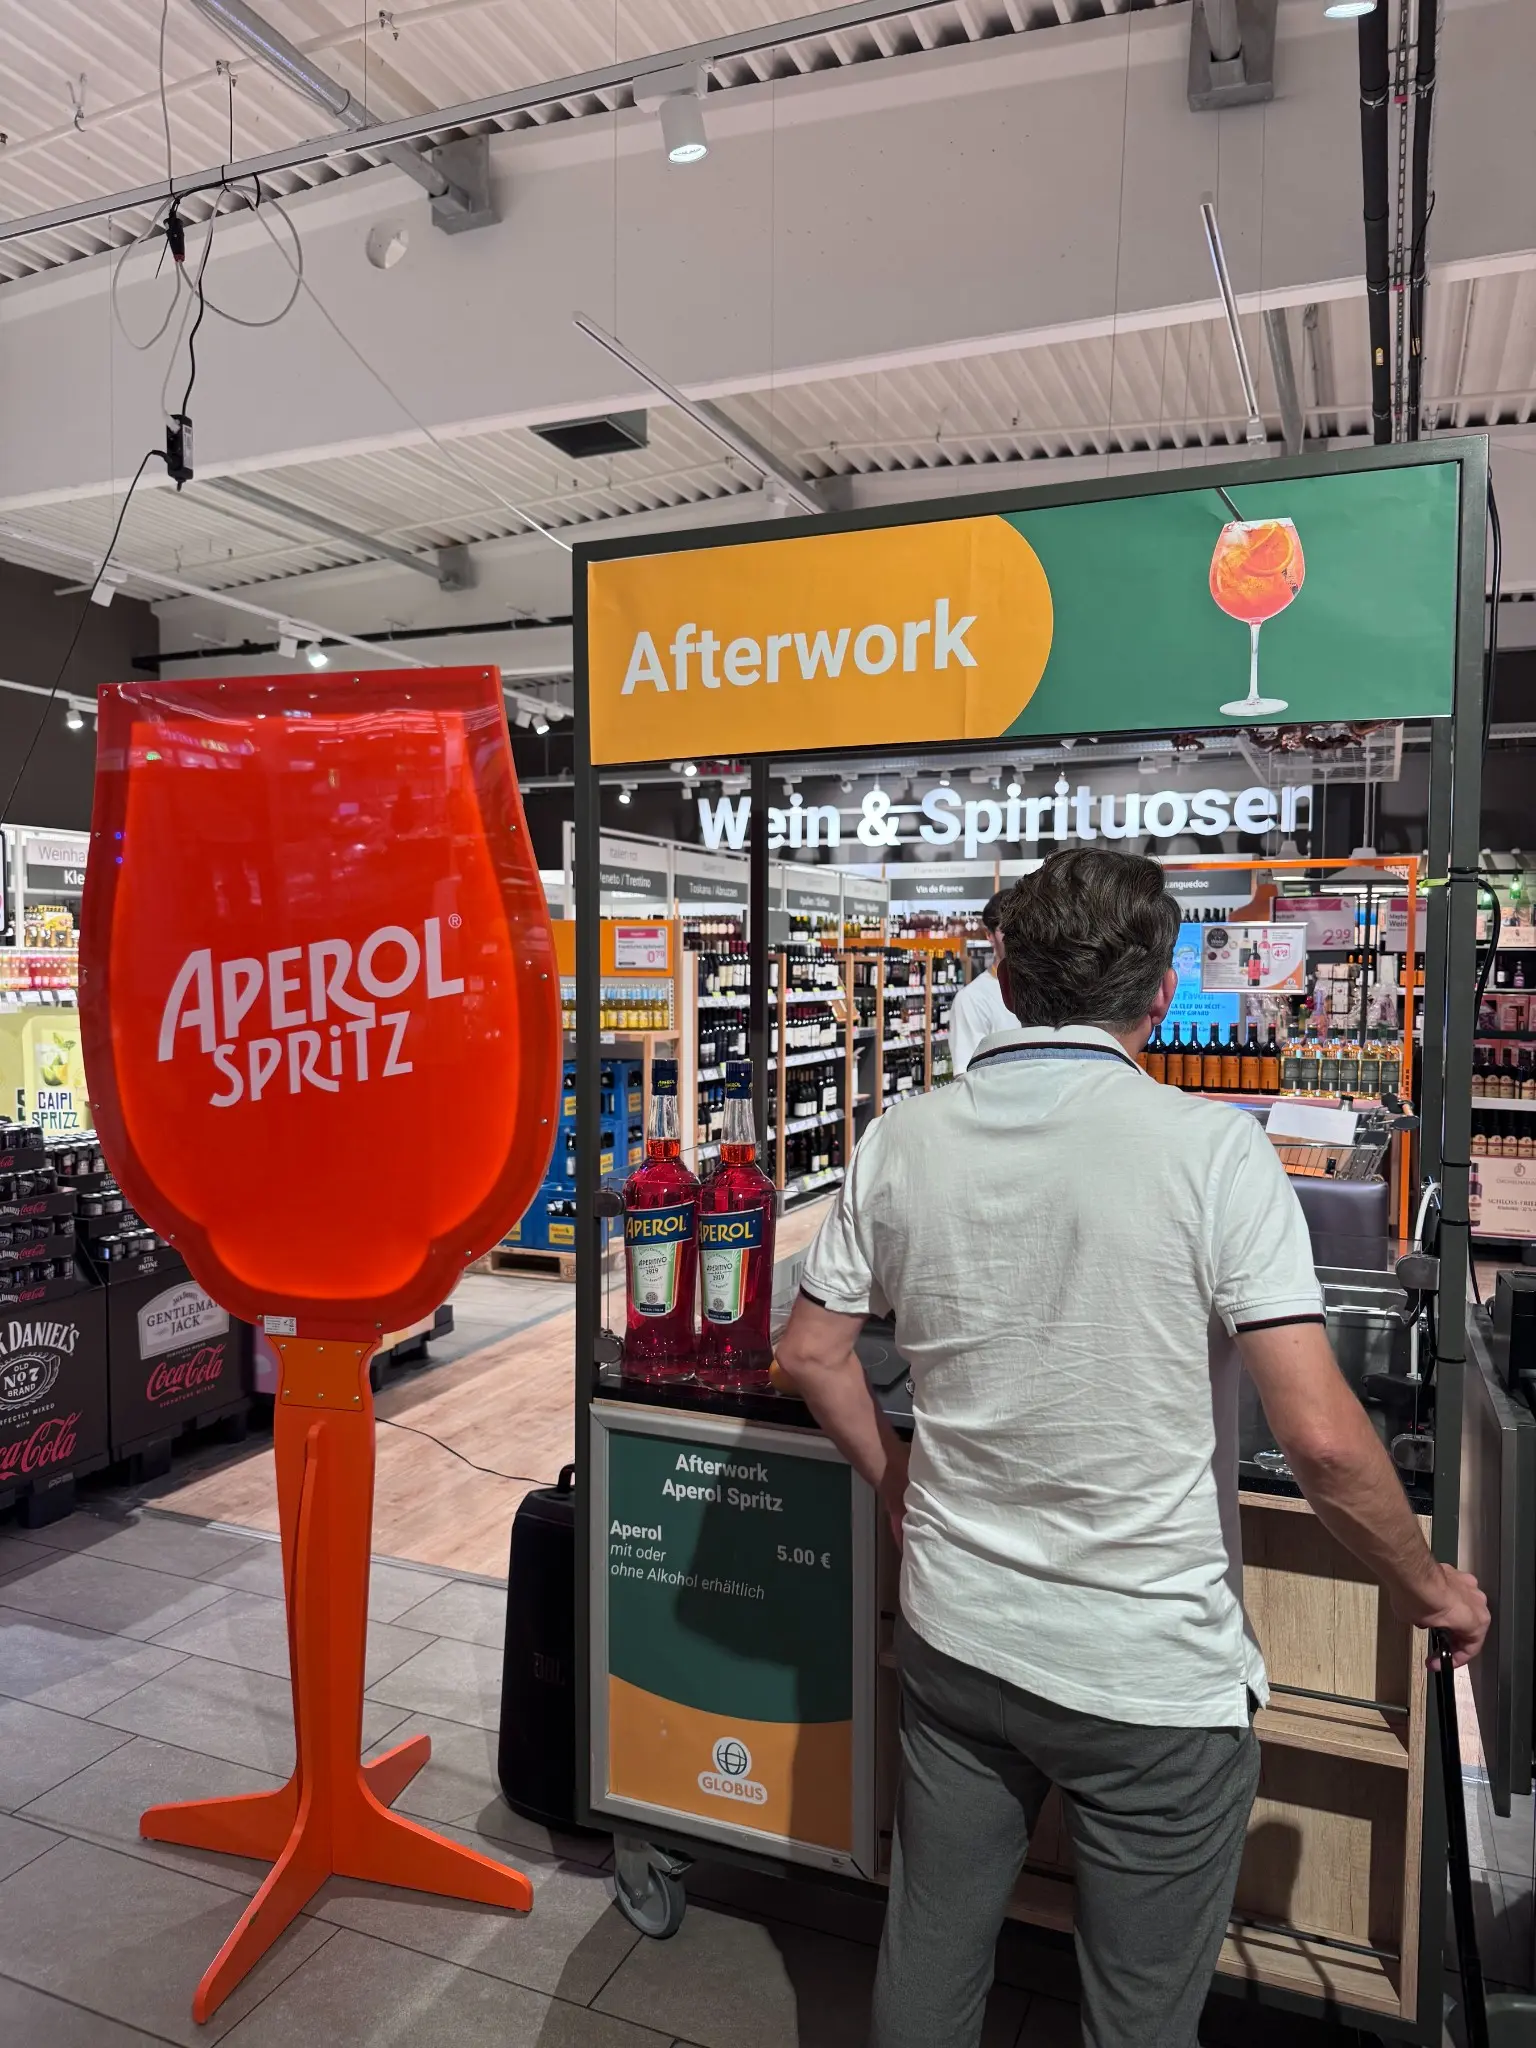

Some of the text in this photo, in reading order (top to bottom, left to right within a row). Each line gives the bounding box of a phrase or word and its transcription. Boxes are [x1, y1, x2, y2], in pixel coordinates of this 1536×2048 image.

[621, 598, 978, 695] Afterwork
[697, 780, 1313, 858] Wein & Spirituosen
[38, 1092, 72, 1110] CAIPI
[32, 1112, 80, 1129] SPRIZZ
[625, 1215, 687, 1239] APEROL
[147, 1299, 219, 1327] GENTLEMA
[171, 1314, 201, 1336] JACK
[8, 1320, 80, 1354] DANIEL'S
[14, 1363, 29, 1372] OLD
[8, 1383, 36, 1397] BRAND
[32, 1403, 55, 1415] MIXED
[675, 1453, 769, 1483] Afterwork
[662, 1479, 784, 1512] Aperol Spritz
[610, 1519, 662, 1541] Aperol
[610, 1543, 667, 1562] mit oder
[777, 1545, 831, 1569] 5.00 €
[611, 1563, 765, 1600] ohne Alkohol erhältlich
[702, 1776, 764, 1800] GLOBUS
